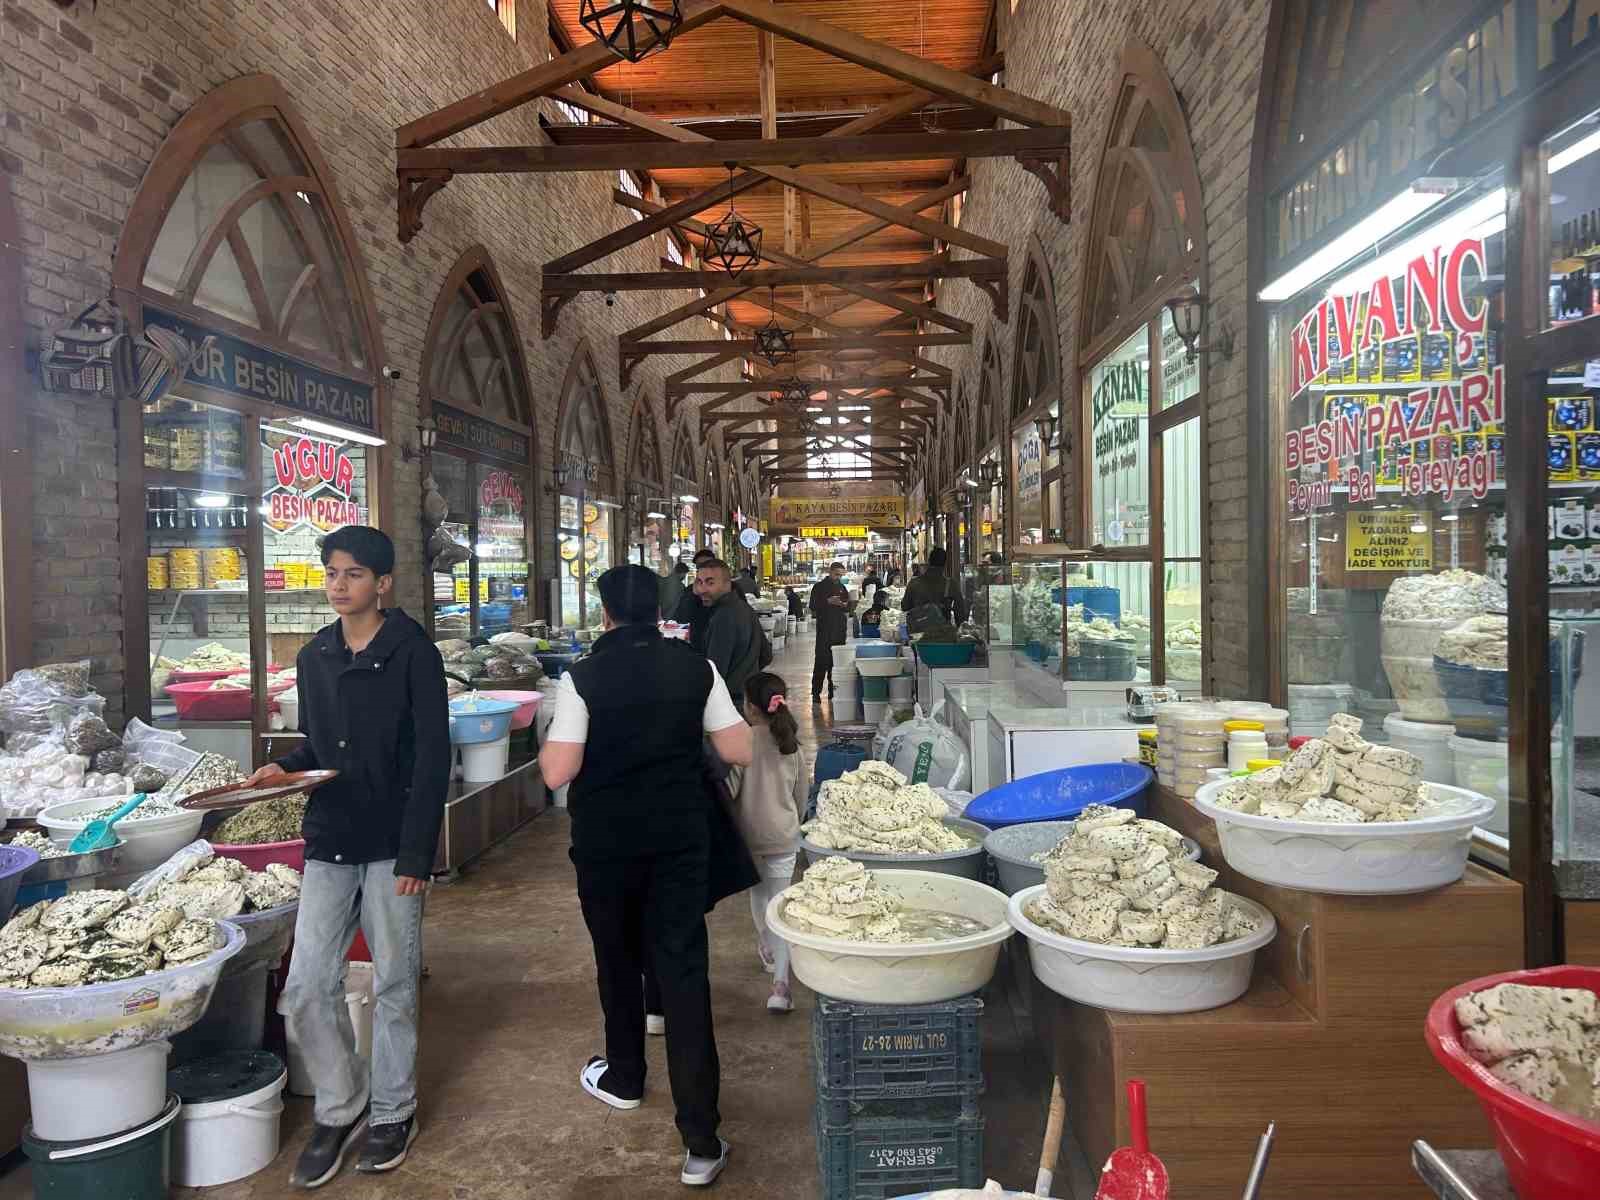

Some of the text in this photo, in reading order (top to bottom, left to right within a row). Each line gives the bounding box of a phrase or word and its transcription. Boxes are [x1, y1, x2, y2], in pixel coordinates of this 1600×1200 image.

[1291, 239, 1489, 400] KIVANÇ
[234, 353, 299, 400] BESİN
[304, 379, 371, 425] PAZARI
[1093, 359, 1142, 431] KENAN
[1286, 364, 1504, 471] BESİN PAZARI
[1289, 439, 1498, 513] Peynir Bal Tereyağı
[271, 490, 359, 526] BESİN PAZARI
[1380, 559, 1430, 567] YOKTUR
[1408, 548, 1425, 556] VE
[893, 1034, 924, 1049] TARIM
[876, 1154, 936, 1167] SERHAT
